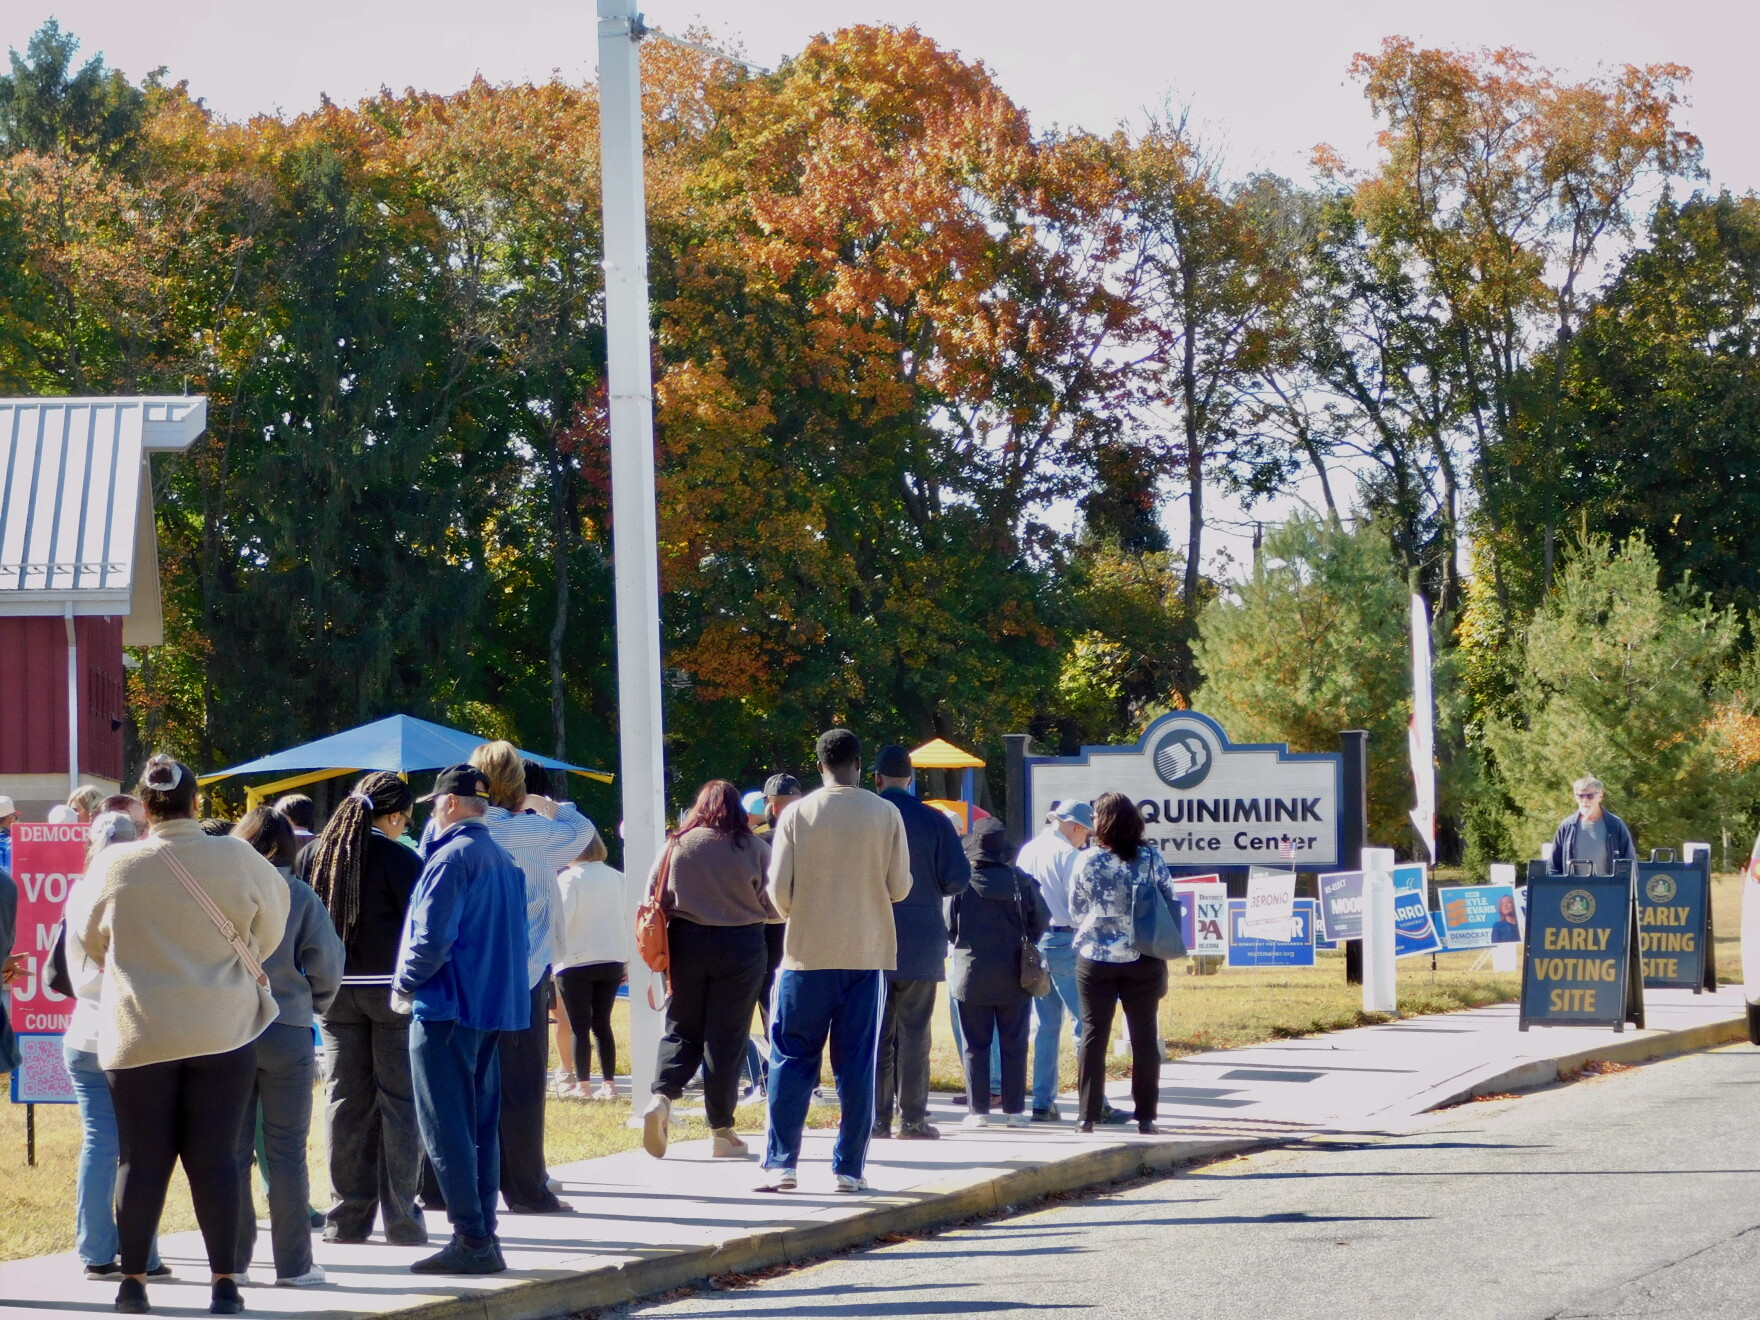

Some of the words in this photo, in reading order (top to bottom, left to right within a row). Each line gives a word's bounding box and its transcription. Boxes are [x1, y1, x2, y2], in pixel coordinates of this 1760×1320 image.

[1046, 798, 1323, 824] QUINIMINK
[20, 826, 91, 842] DEMOCR
[1147, 832, 1221, 851] ervice
[1234, 832, 1317, 850] Center
[1325, 879, 1346, 894] RE-ELECT
[1466, 897, 1488, 906] KYLE
[1467, 905, 1496, 914] EVANS
[1469, 914, 1487, 923] GAY
[1638, 906, 1690, 926] EARLY
[1450, 932, 1489, 940] DEMOCRAT
[1544, 927, 1612, 951] EARLY
[1639, 932, 1695, 952] OTING
[1534, 958, 1616, 982] VOTING
[1642, 958, 1678, 978] SITE
[1549, 989, 1597, 1012] SITE
